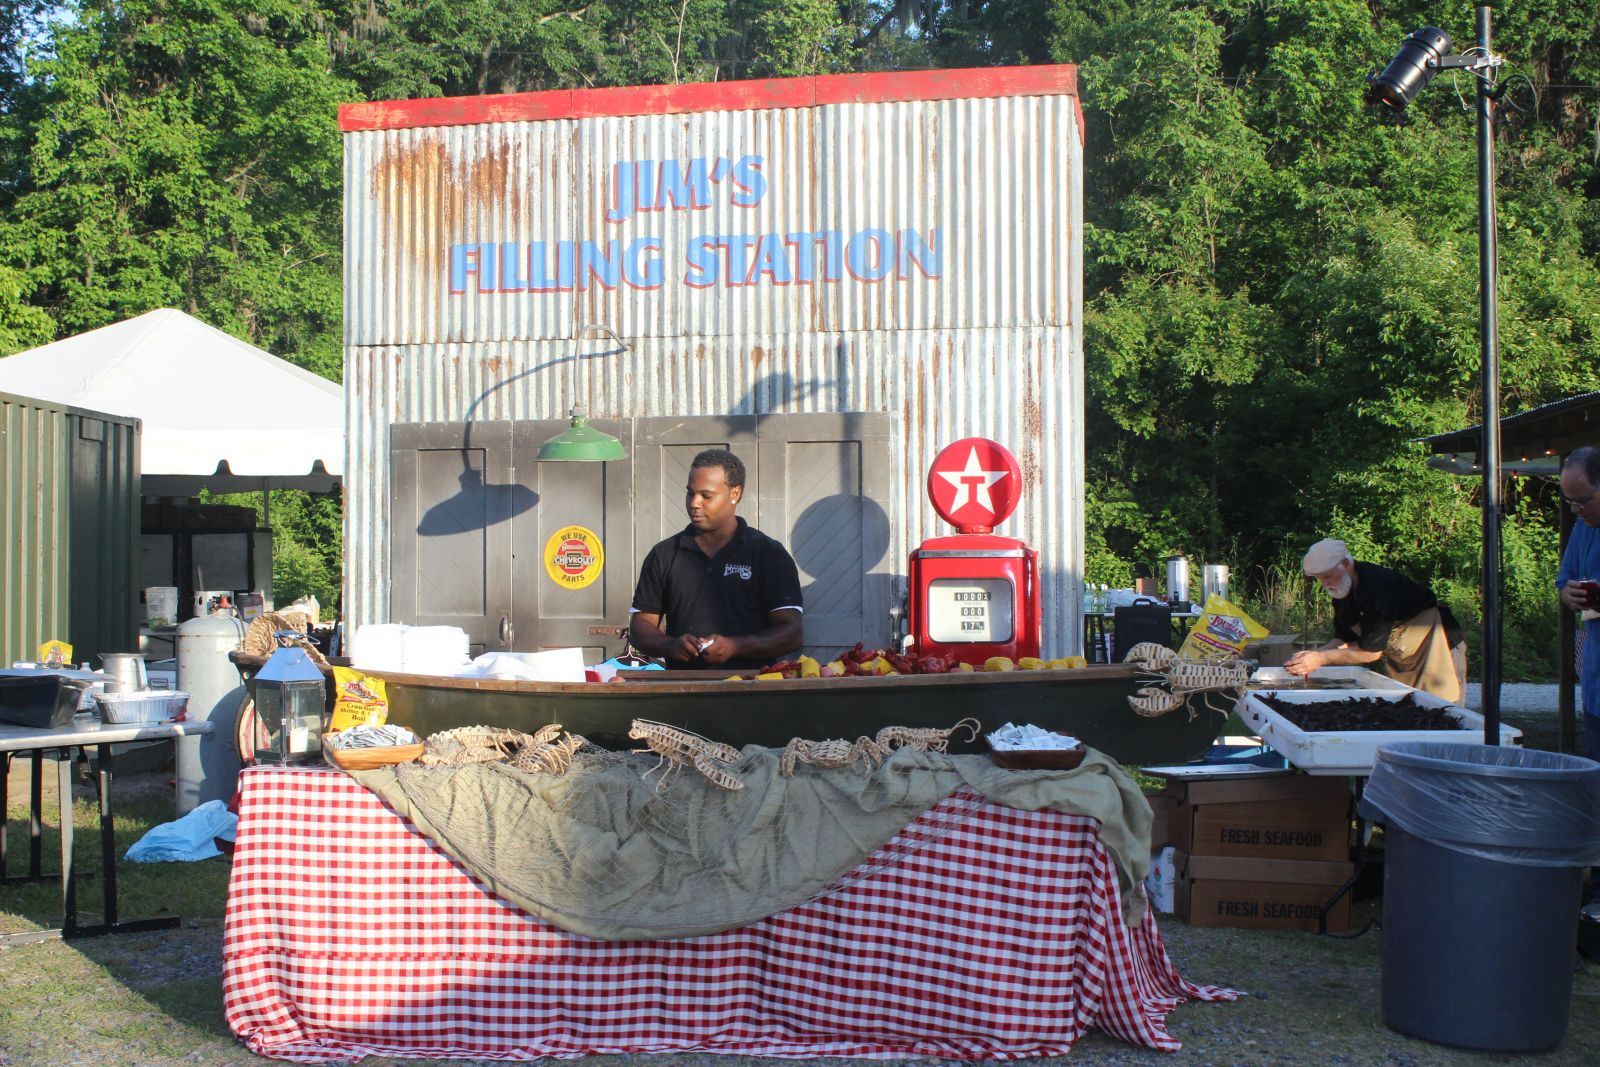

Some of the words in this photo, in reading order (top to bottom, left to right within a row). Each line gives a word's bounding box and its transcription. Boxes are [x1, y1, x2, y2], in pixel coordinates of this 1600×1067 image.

[605, 154, 768, 223] JIM'S
[449, 238, 665, 295] FILLING
[683, 227, 944, 287] STATION
[561, 533, 571, 541] WE
[574, 533, 587, 541] USE
[554, 556, 594, 564] CHEVROLET
[562, 574, 585, 582] PARTS
[1220, 829, 1260, 844] FRESH
[1264, 831, 1322, 846] SEAFOOD
[1218, 901, 1258, 917] FRESH
[1263, 903, 1321, 919] SEAFOOD
